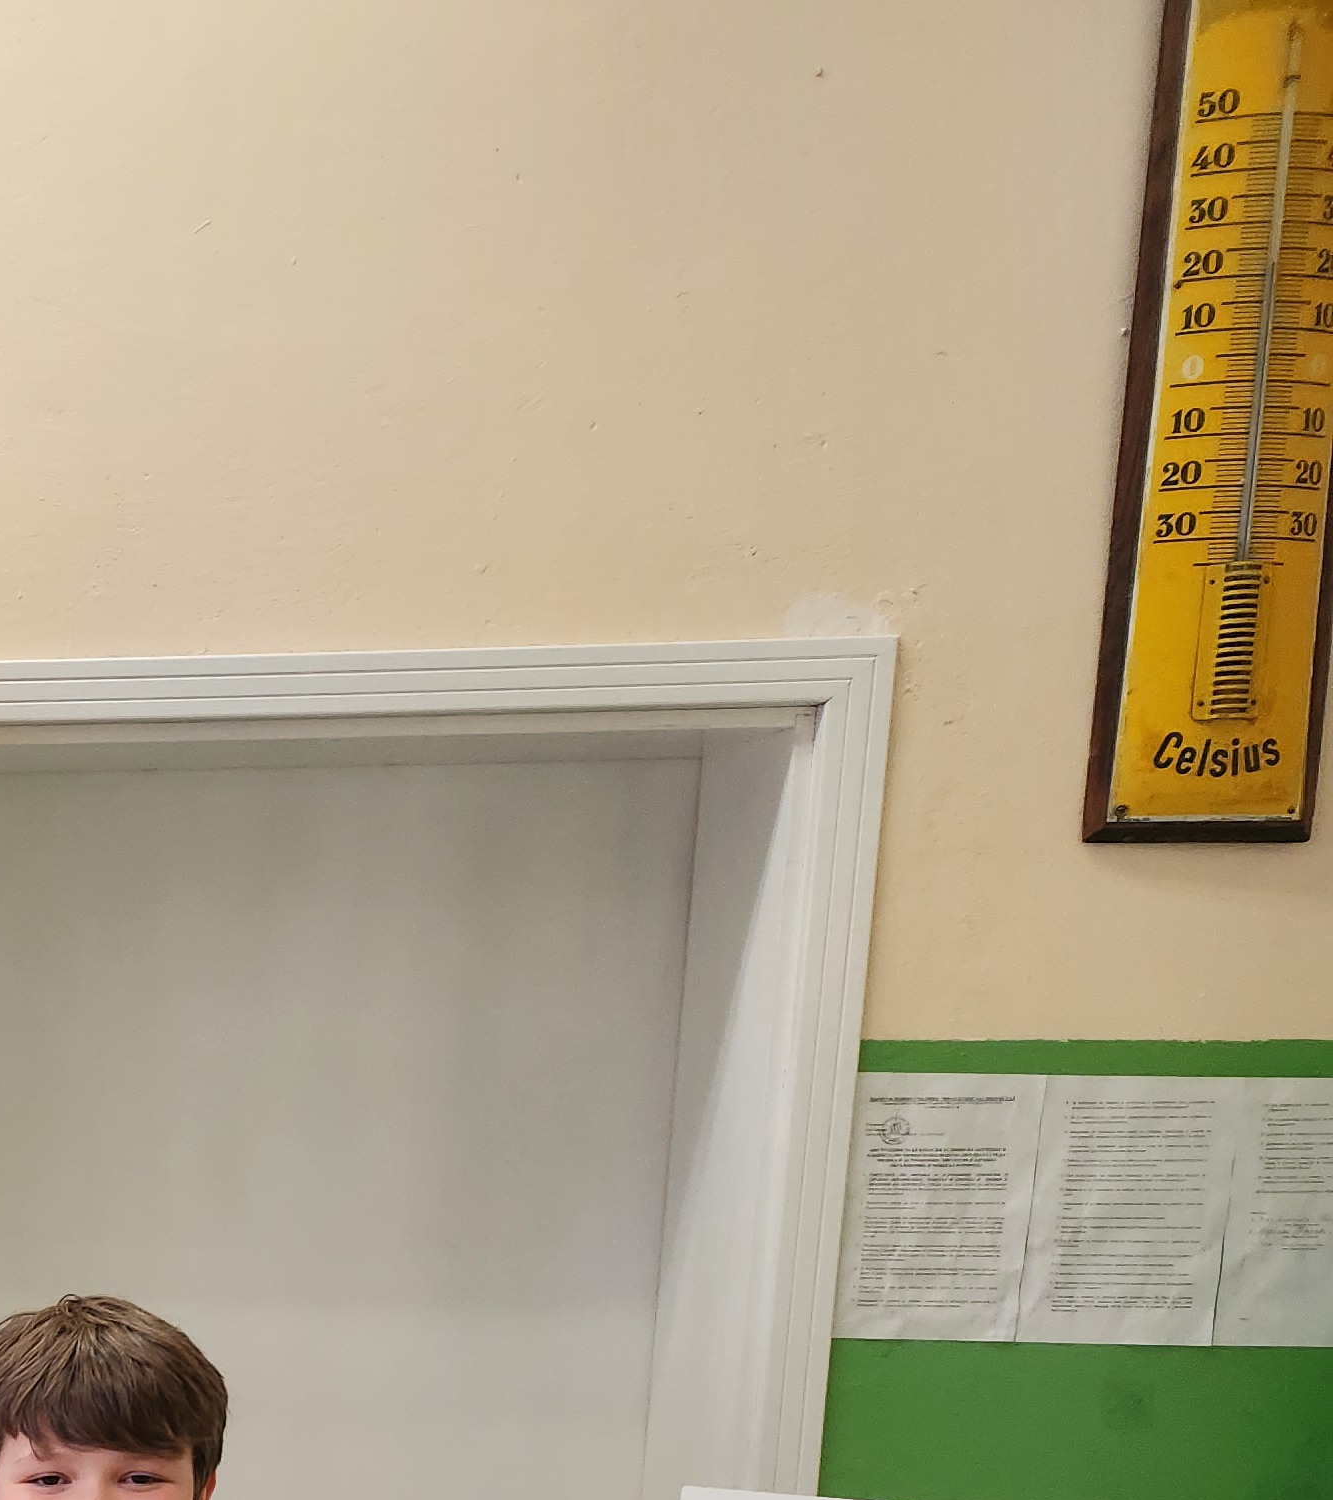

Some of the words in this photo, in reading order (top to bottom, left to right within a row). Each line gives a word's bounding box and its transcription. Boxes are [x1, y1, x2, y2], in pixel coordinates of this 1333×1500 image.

[1197, 87, 1241, 118] 50
[1190, 142, 1235, 171] 40
[1188, 196, 1229, 224] 30
[1182, 249, 1224, 277] 20
[1181, 303, 1216, 330] 10
[1171, 407, 1206, 434] 10
[1302, 407, 1326, 432] 10
[1161, 460, 1202, 486] 20
[1295, 459, 1322, 485] 20
[1155, 511, 1197, 537] 30
[1290, 511, 1318, 536] 30
[1153, 731, 1280, 778] Celsius
